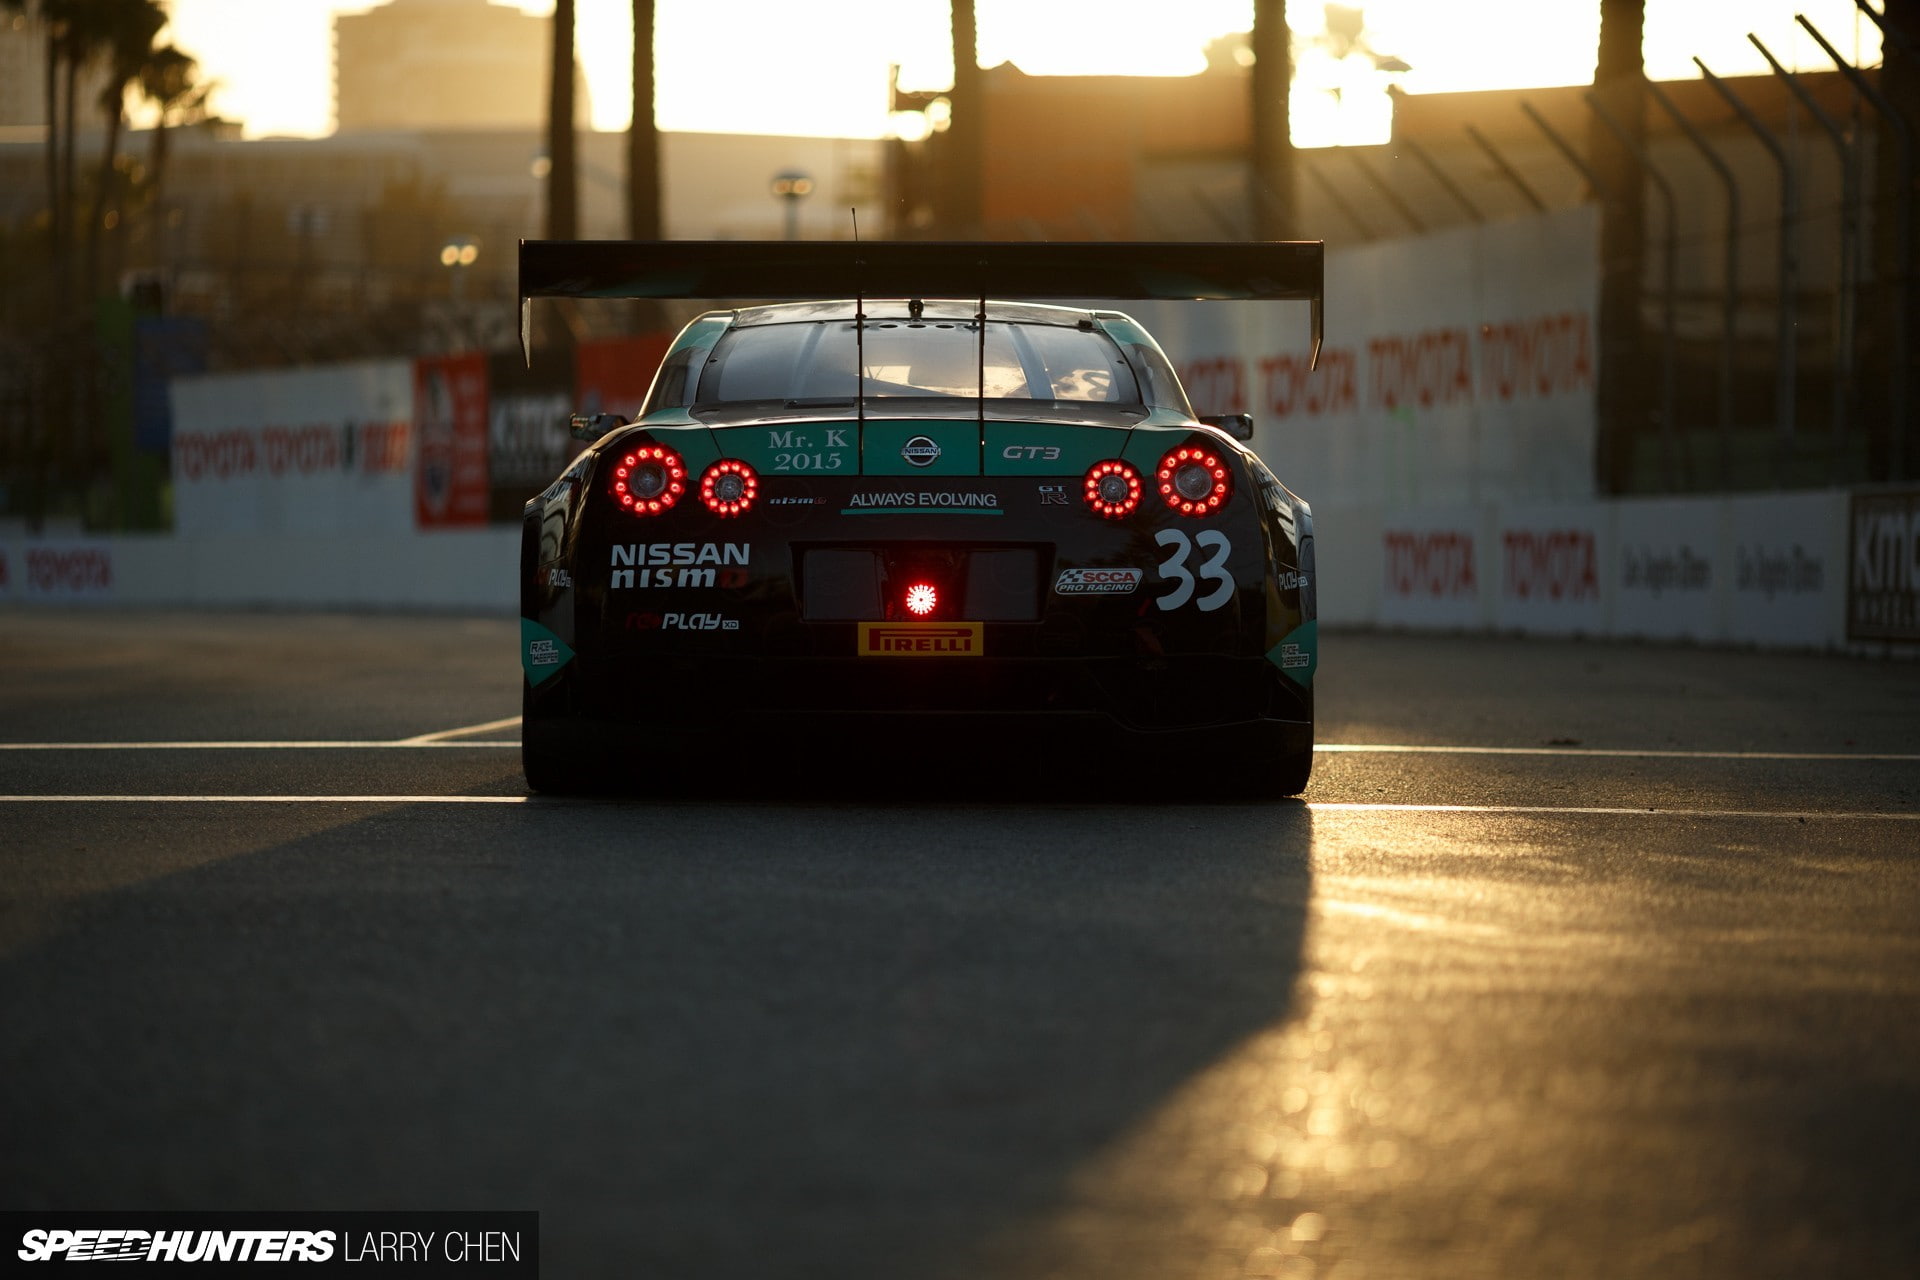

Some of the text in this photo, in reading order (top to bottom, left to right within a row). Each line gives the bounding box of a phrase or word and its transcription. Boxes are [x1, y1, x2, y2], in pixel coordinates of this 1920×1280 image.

[768, 429, 849, 449] Mr. K
[774, 452, 842, 471] 2015
[1002, 445, 1061, 460] GT3
[849, 492, 998, 507] ALWAYS EVOLVING
[610, 543, 750, 566] NISSAN
[1082, 572, 1136, 583] SCCA
[1154, 528, 1236, 612] 33
[1060, 583, 1135, 592] PRO RACING
[869, 628, 974, 651] PIRELLI
